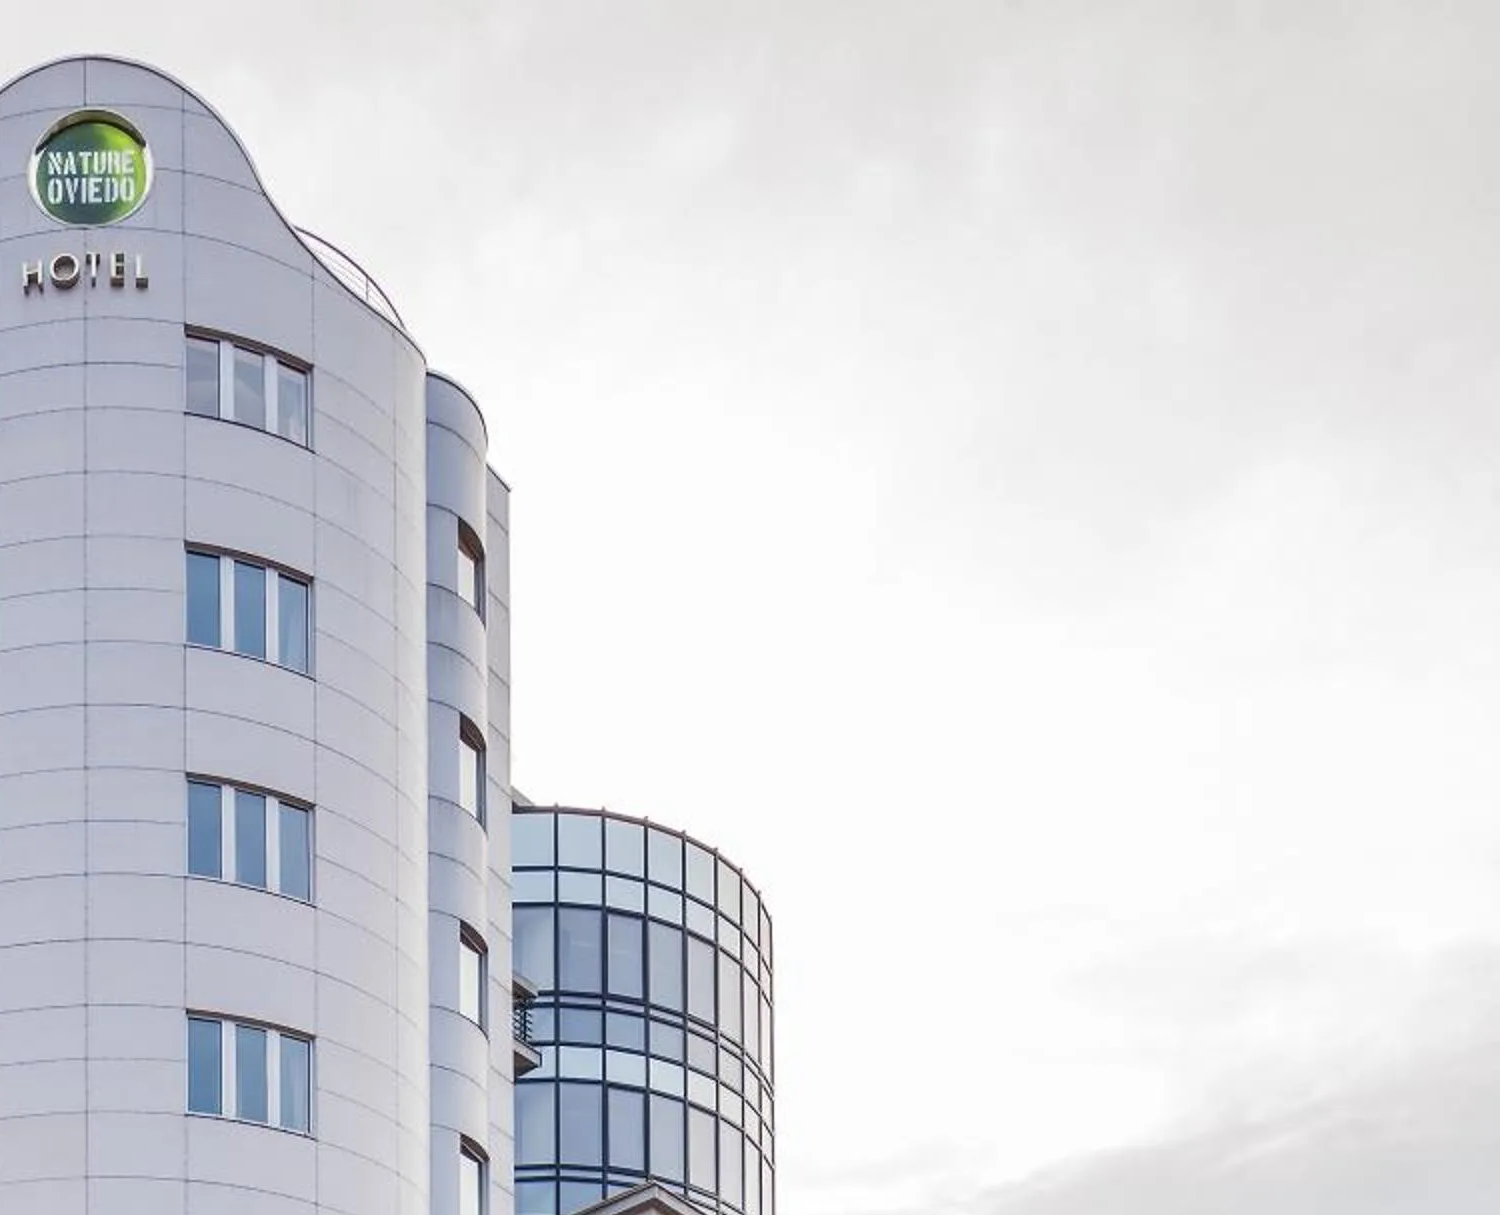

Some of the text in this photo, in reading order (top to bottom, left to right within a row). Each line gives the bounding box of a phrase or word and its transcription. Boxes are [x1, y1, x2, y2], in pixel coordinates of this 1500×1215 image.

[48, 150, 136, 175] NATURE
[47, 177, 136, 204] OVIEDO
[22, 251, 149, 295] HOTEL
